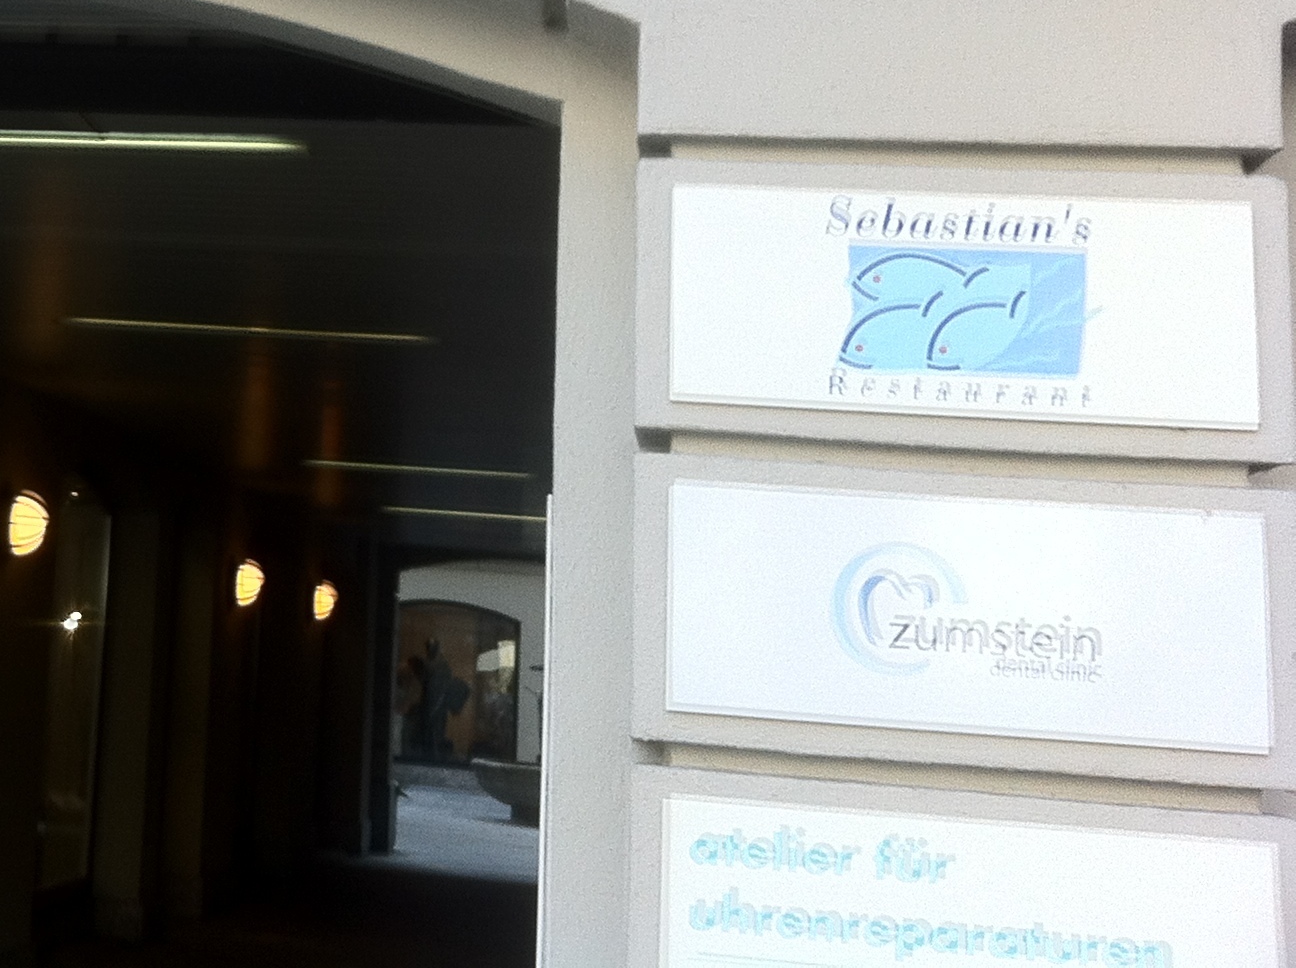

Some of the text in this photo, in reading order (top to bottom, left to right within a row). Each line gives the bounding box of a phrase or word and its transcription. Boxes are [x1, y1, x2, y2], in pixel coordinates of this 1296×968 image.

[825, 196, 1092, 245] Sebastian's
[828, 371, 1091, 408] Restaurant
[889, 620, 1098, 662] zumstein
[689, 829, 952, 883] atelier für
[689, 891, 1172, 968] uhrenreparaturen
